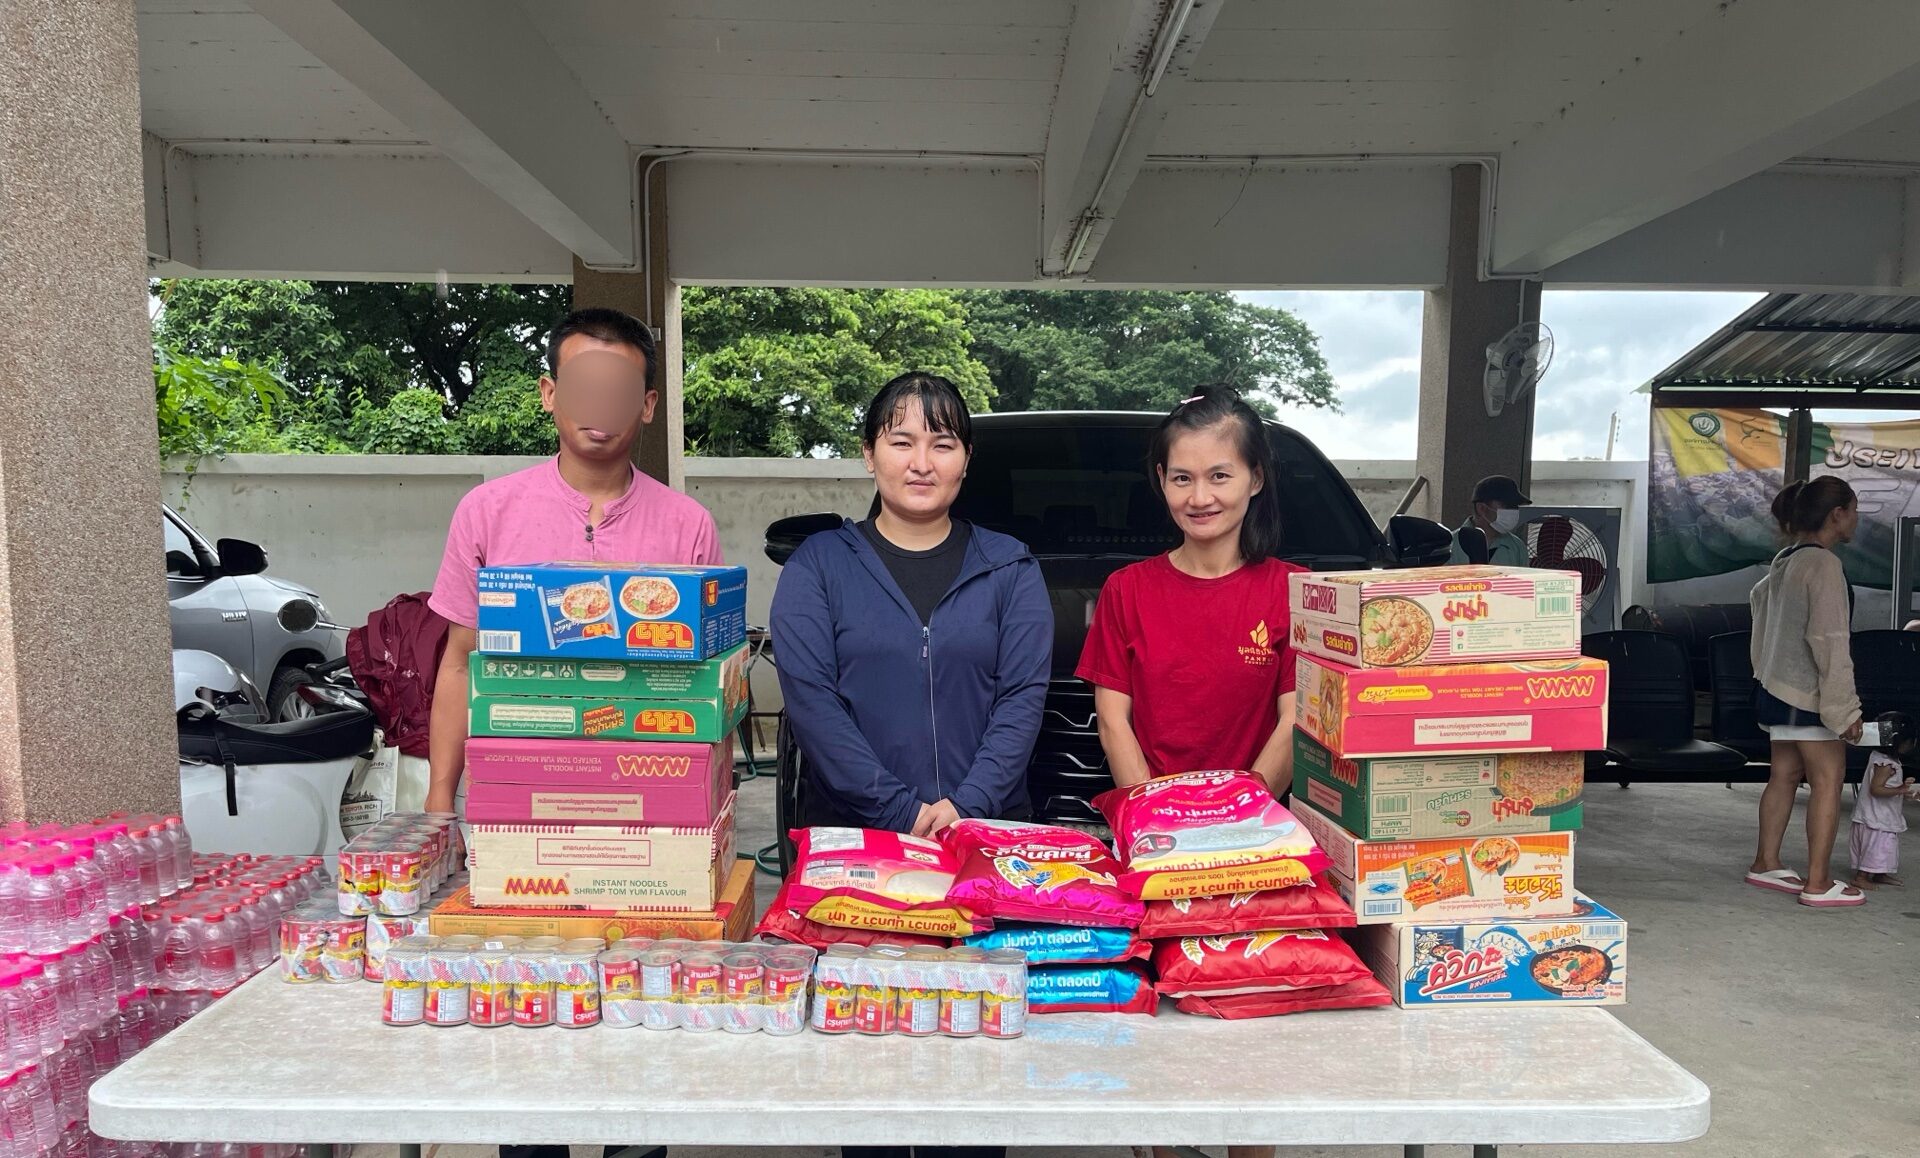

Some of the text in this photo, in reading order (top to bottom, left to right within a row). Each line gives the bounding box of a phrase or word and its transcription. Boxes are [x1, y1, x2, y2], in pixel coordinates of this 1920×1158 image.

[1443, 595, 1489, 621] มาม่า
[1526, 676, 1595, 700] MAMA
[617, 755, 691, 777] MAMA
[1491, 797, 1535, 817] มาม่า
[505, 877, 570, 896] MAMA
[630, 880, 668, 888] NOODLES
[1250, 876, 1300, 888] หอมกว่า
[1164, 888, 1184, 896] เท่า
[1189, 887, 1198, 895] 2
[827, 912, 847, 923] เท่า
[850, 914, 859, 924] 2
[862, 911, 908, 930] นุ่มกว่า
[913, 918, 957, 933] หอมกว่า
[1002, 929, 1091, 947] นุ่มกว่า ตลอดปี
[1429, 951, 1483, 986] ควิก
[1057, 973, 1101, 986] ตลอดปี
